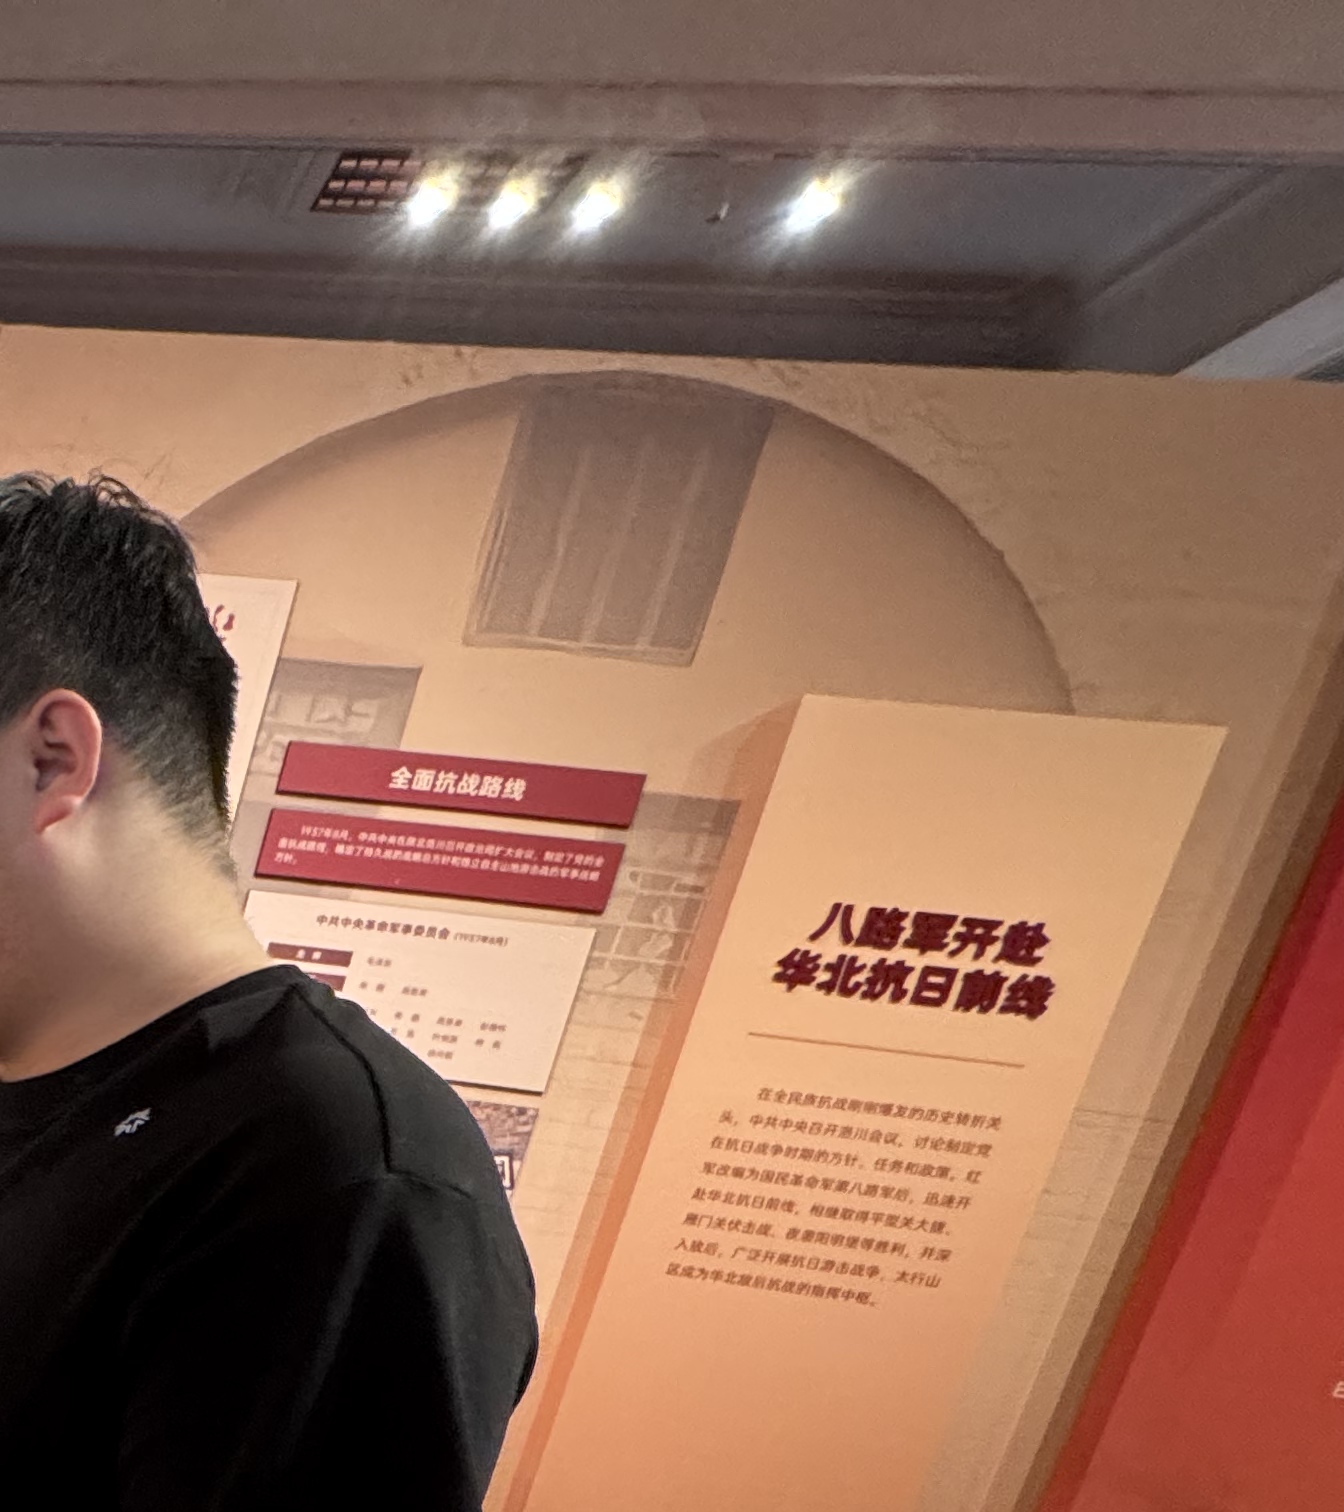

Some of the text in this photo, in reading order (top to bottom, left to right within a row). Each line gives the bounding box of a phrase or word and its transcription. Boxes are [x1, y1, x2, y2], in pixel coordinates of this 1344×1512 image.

[388, 766, 527, 801] 全面抗战路线
[809, 902, 1051, 966] 八路军开赴
[771, 947, 1056, 1020] 华北抗日前线
